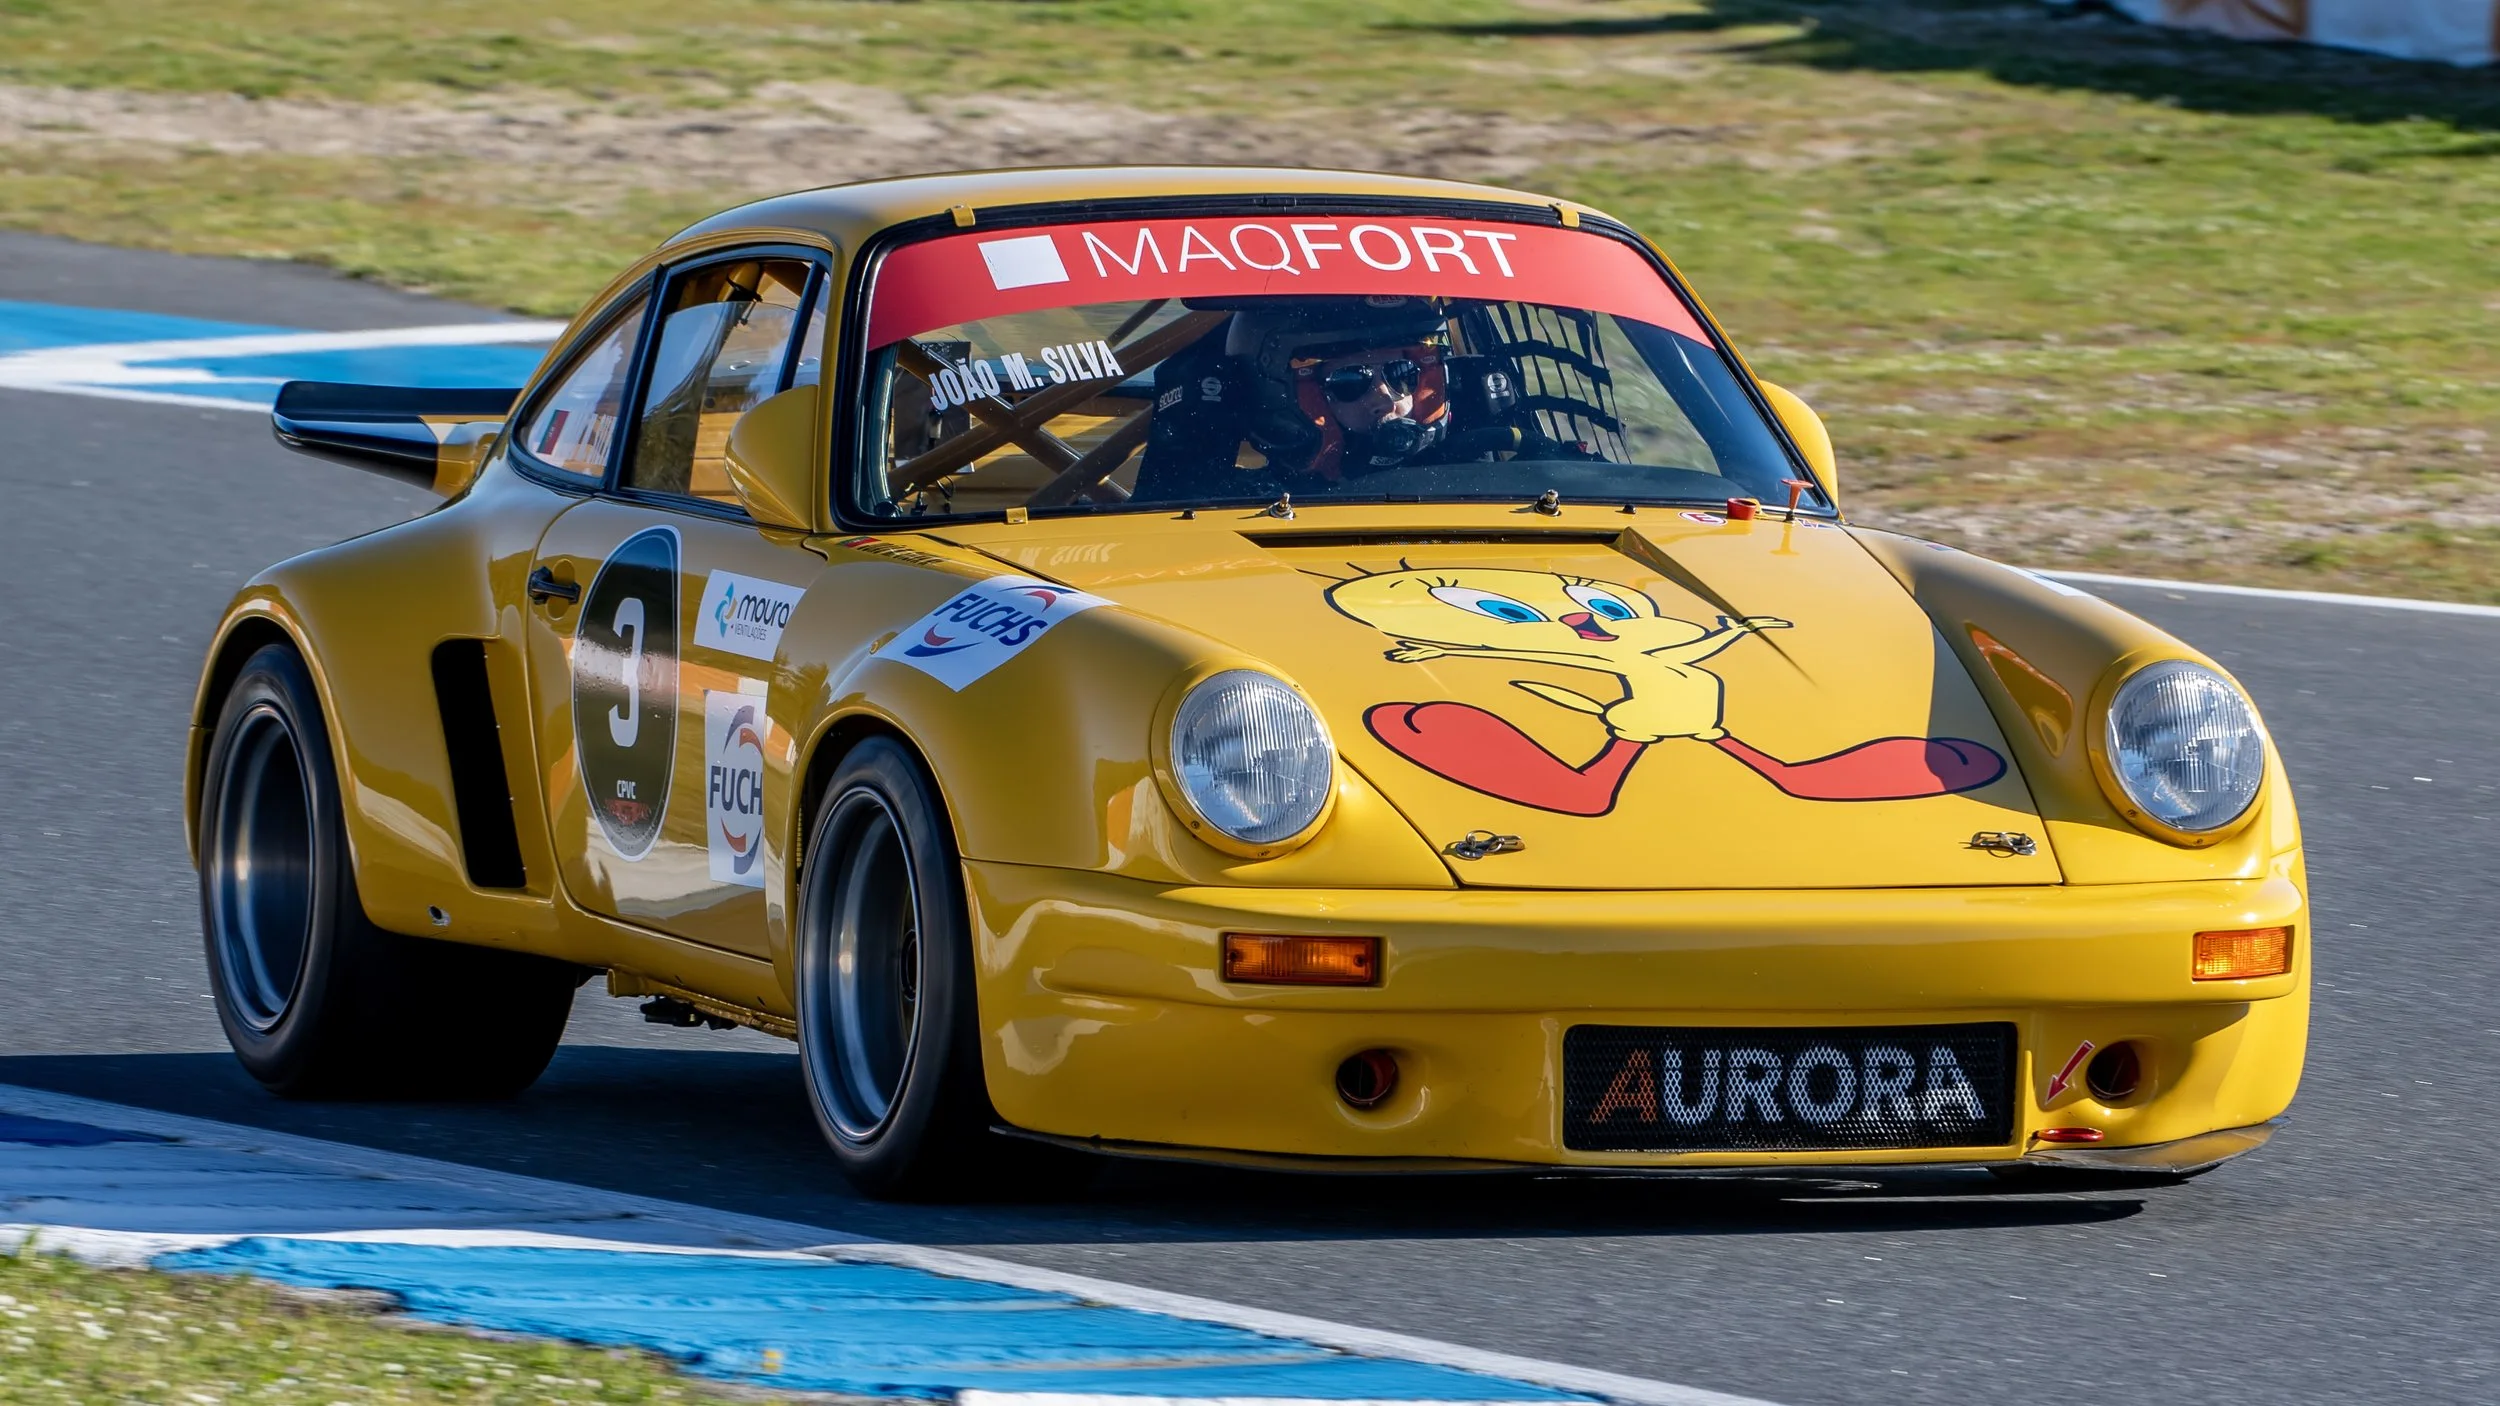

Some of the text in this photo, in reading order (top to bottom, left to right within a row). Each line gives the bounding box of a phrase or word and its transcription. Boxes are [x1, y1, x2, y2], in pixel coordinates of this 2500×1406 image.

[1081, 223, 1517, 278] MAQFORT
[928, 340, 1125, 411] JOÃO M. SILVA
[933, 593, 1048, 646] FUCHS
[608, 597, 645, 748] 3
[709, 765, 763, 815] FUCH
[1588, 1046, 1987, 1124] AURORA
